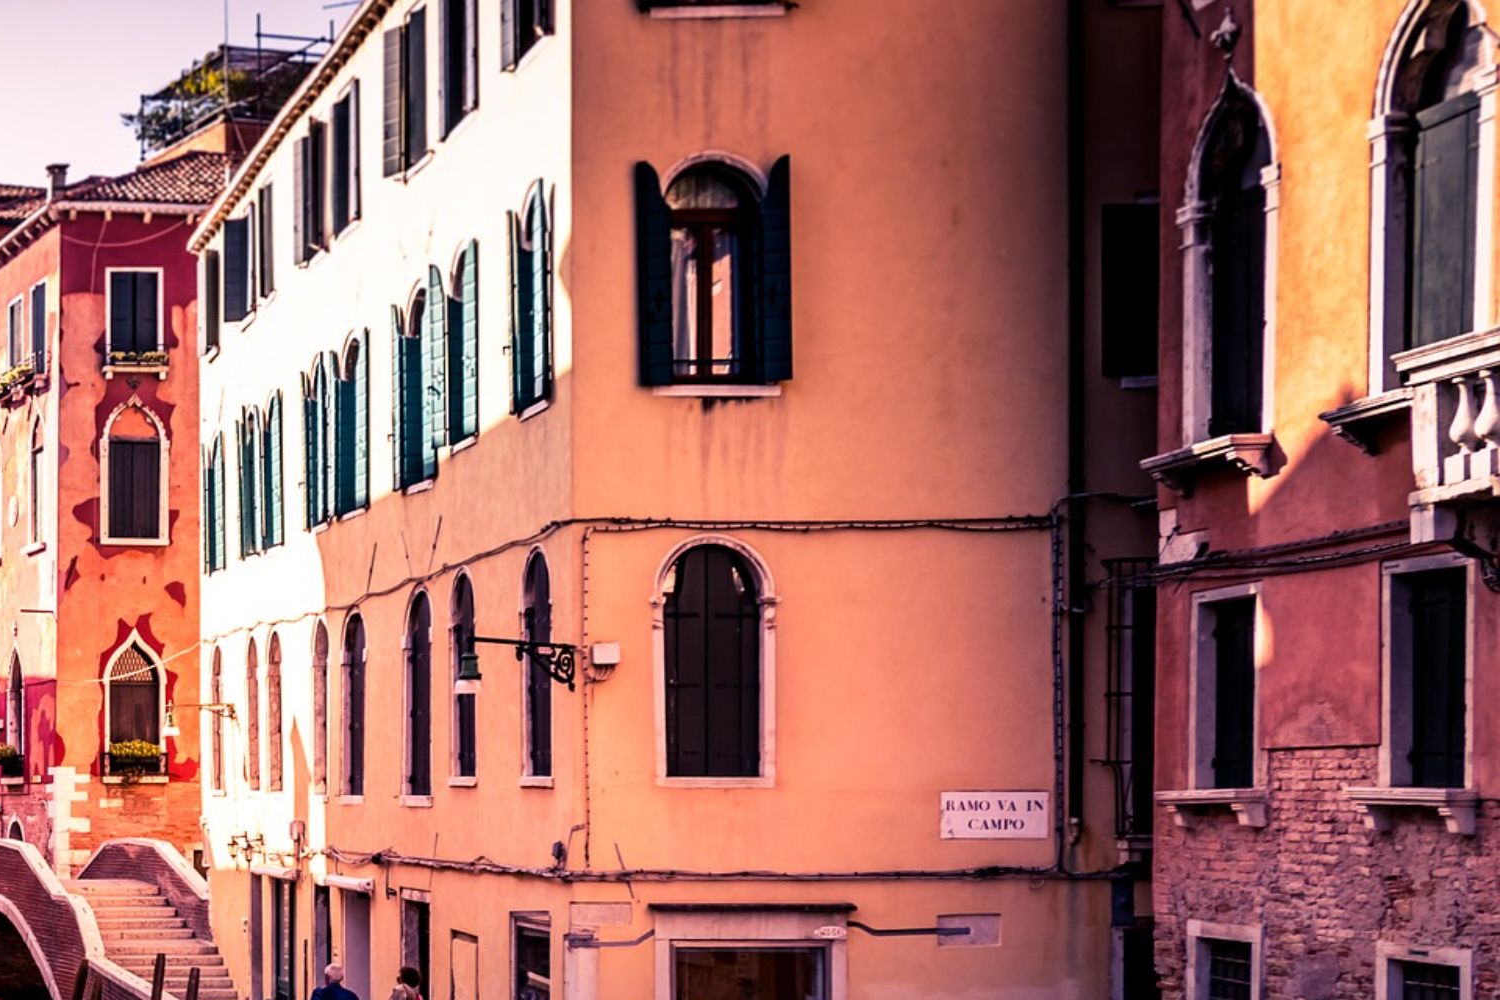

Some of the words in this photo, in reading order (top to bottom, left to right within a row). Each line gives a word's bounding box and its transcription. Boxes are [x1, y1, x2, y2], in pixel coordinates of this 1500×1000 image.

[946, 800, 991, 811] RAMO
[997, 800, 1016, 811] VA
[1027, 800, 1044, 811] IN
[967, 819, 1025, 830] CAMPO
